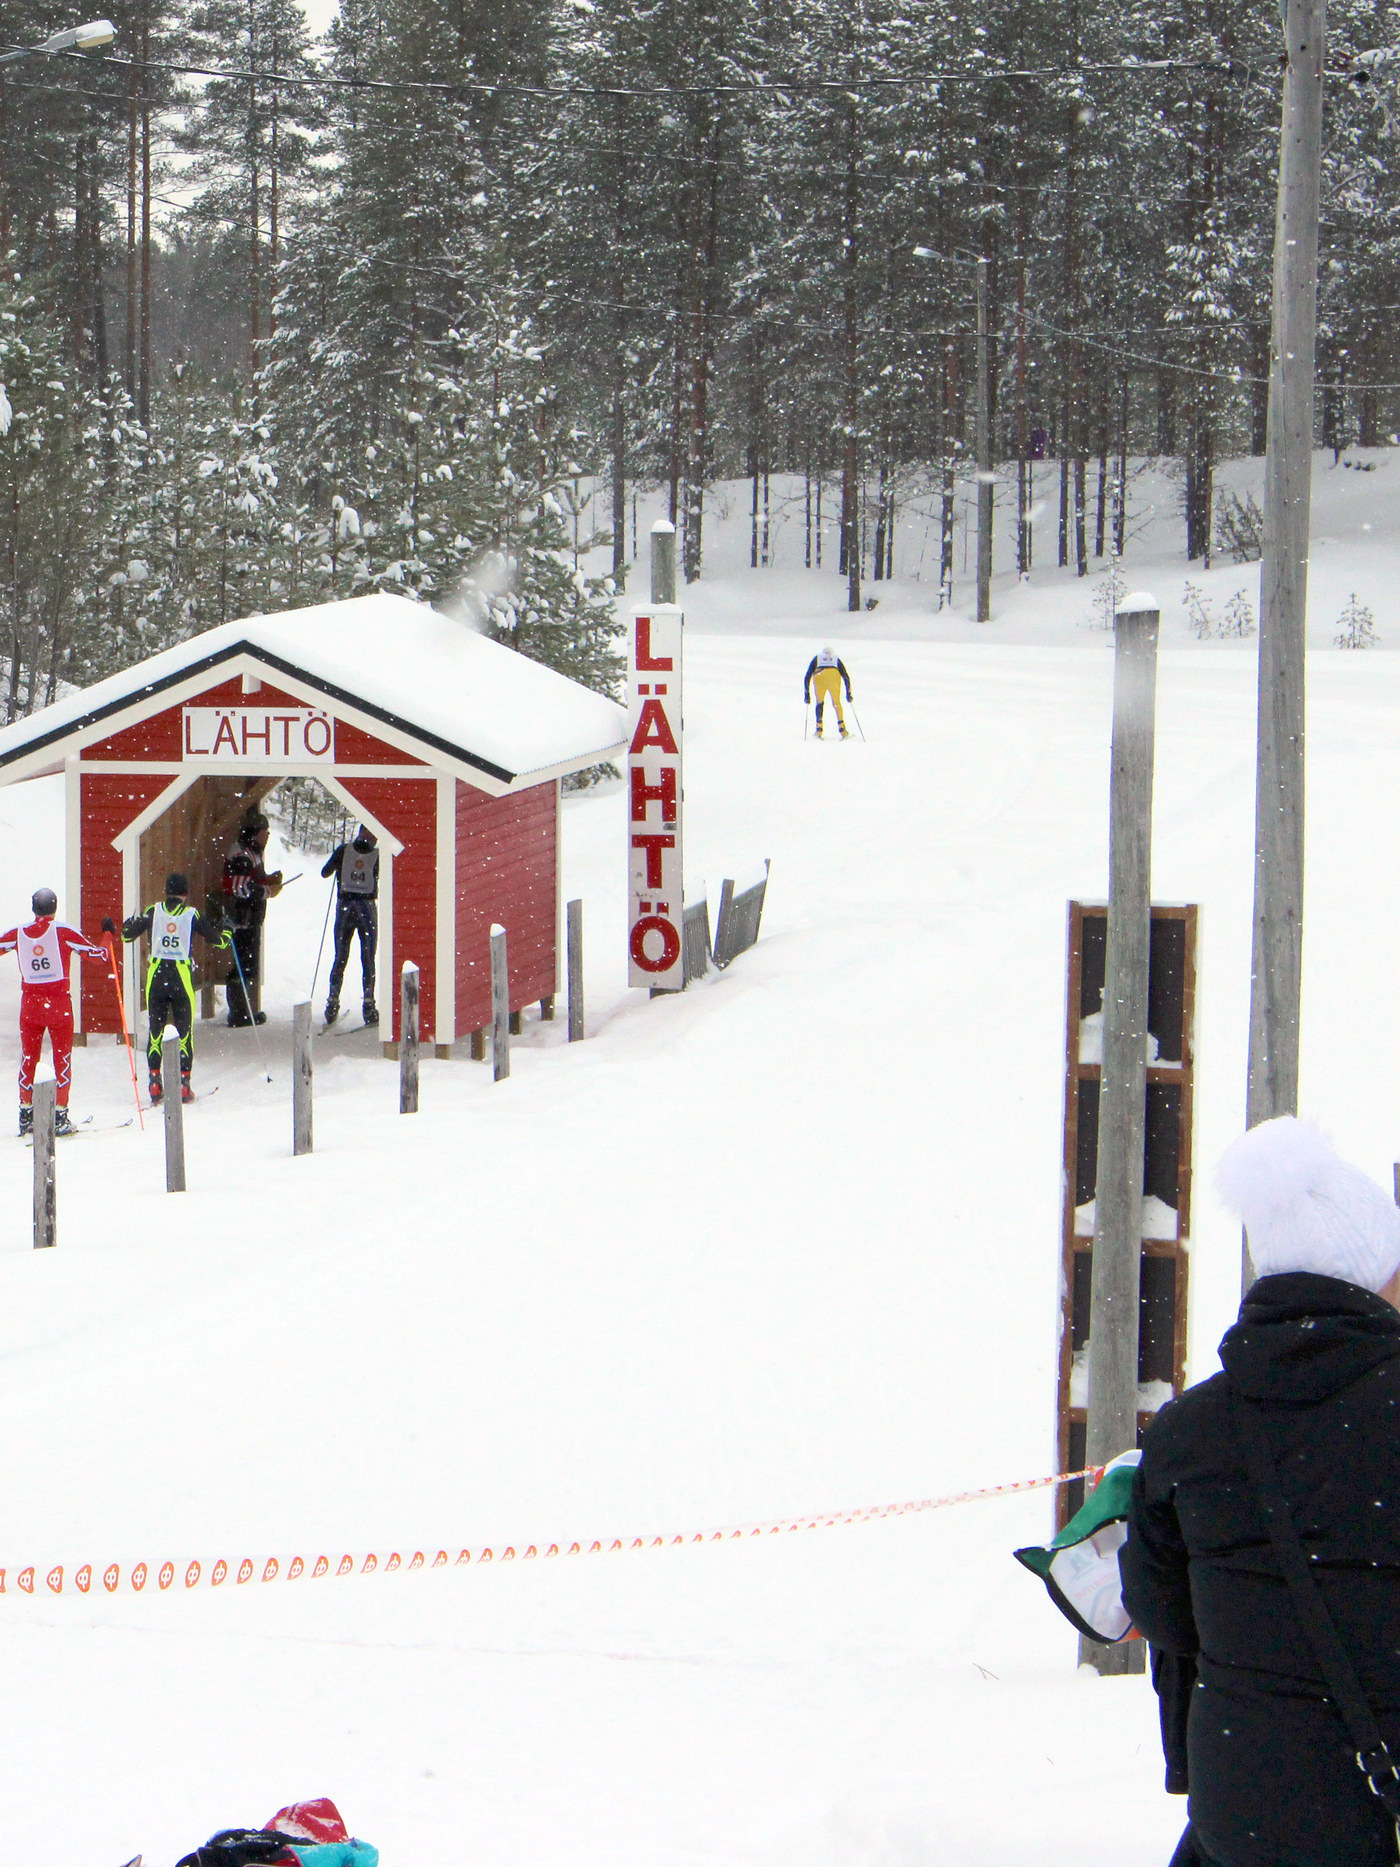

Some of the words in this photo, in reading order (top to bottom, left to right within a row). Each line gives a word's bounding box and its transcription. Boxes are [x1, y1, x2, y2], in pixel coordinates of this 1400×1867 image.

[185, 710, 331, 756] LÄHTÖ
[629, 617, 680, 972] LÄHTÖ
[351, 871, 365, 882] 64
[162, 936, 179, 948] 65
[31, 957, 50, 971] 66
